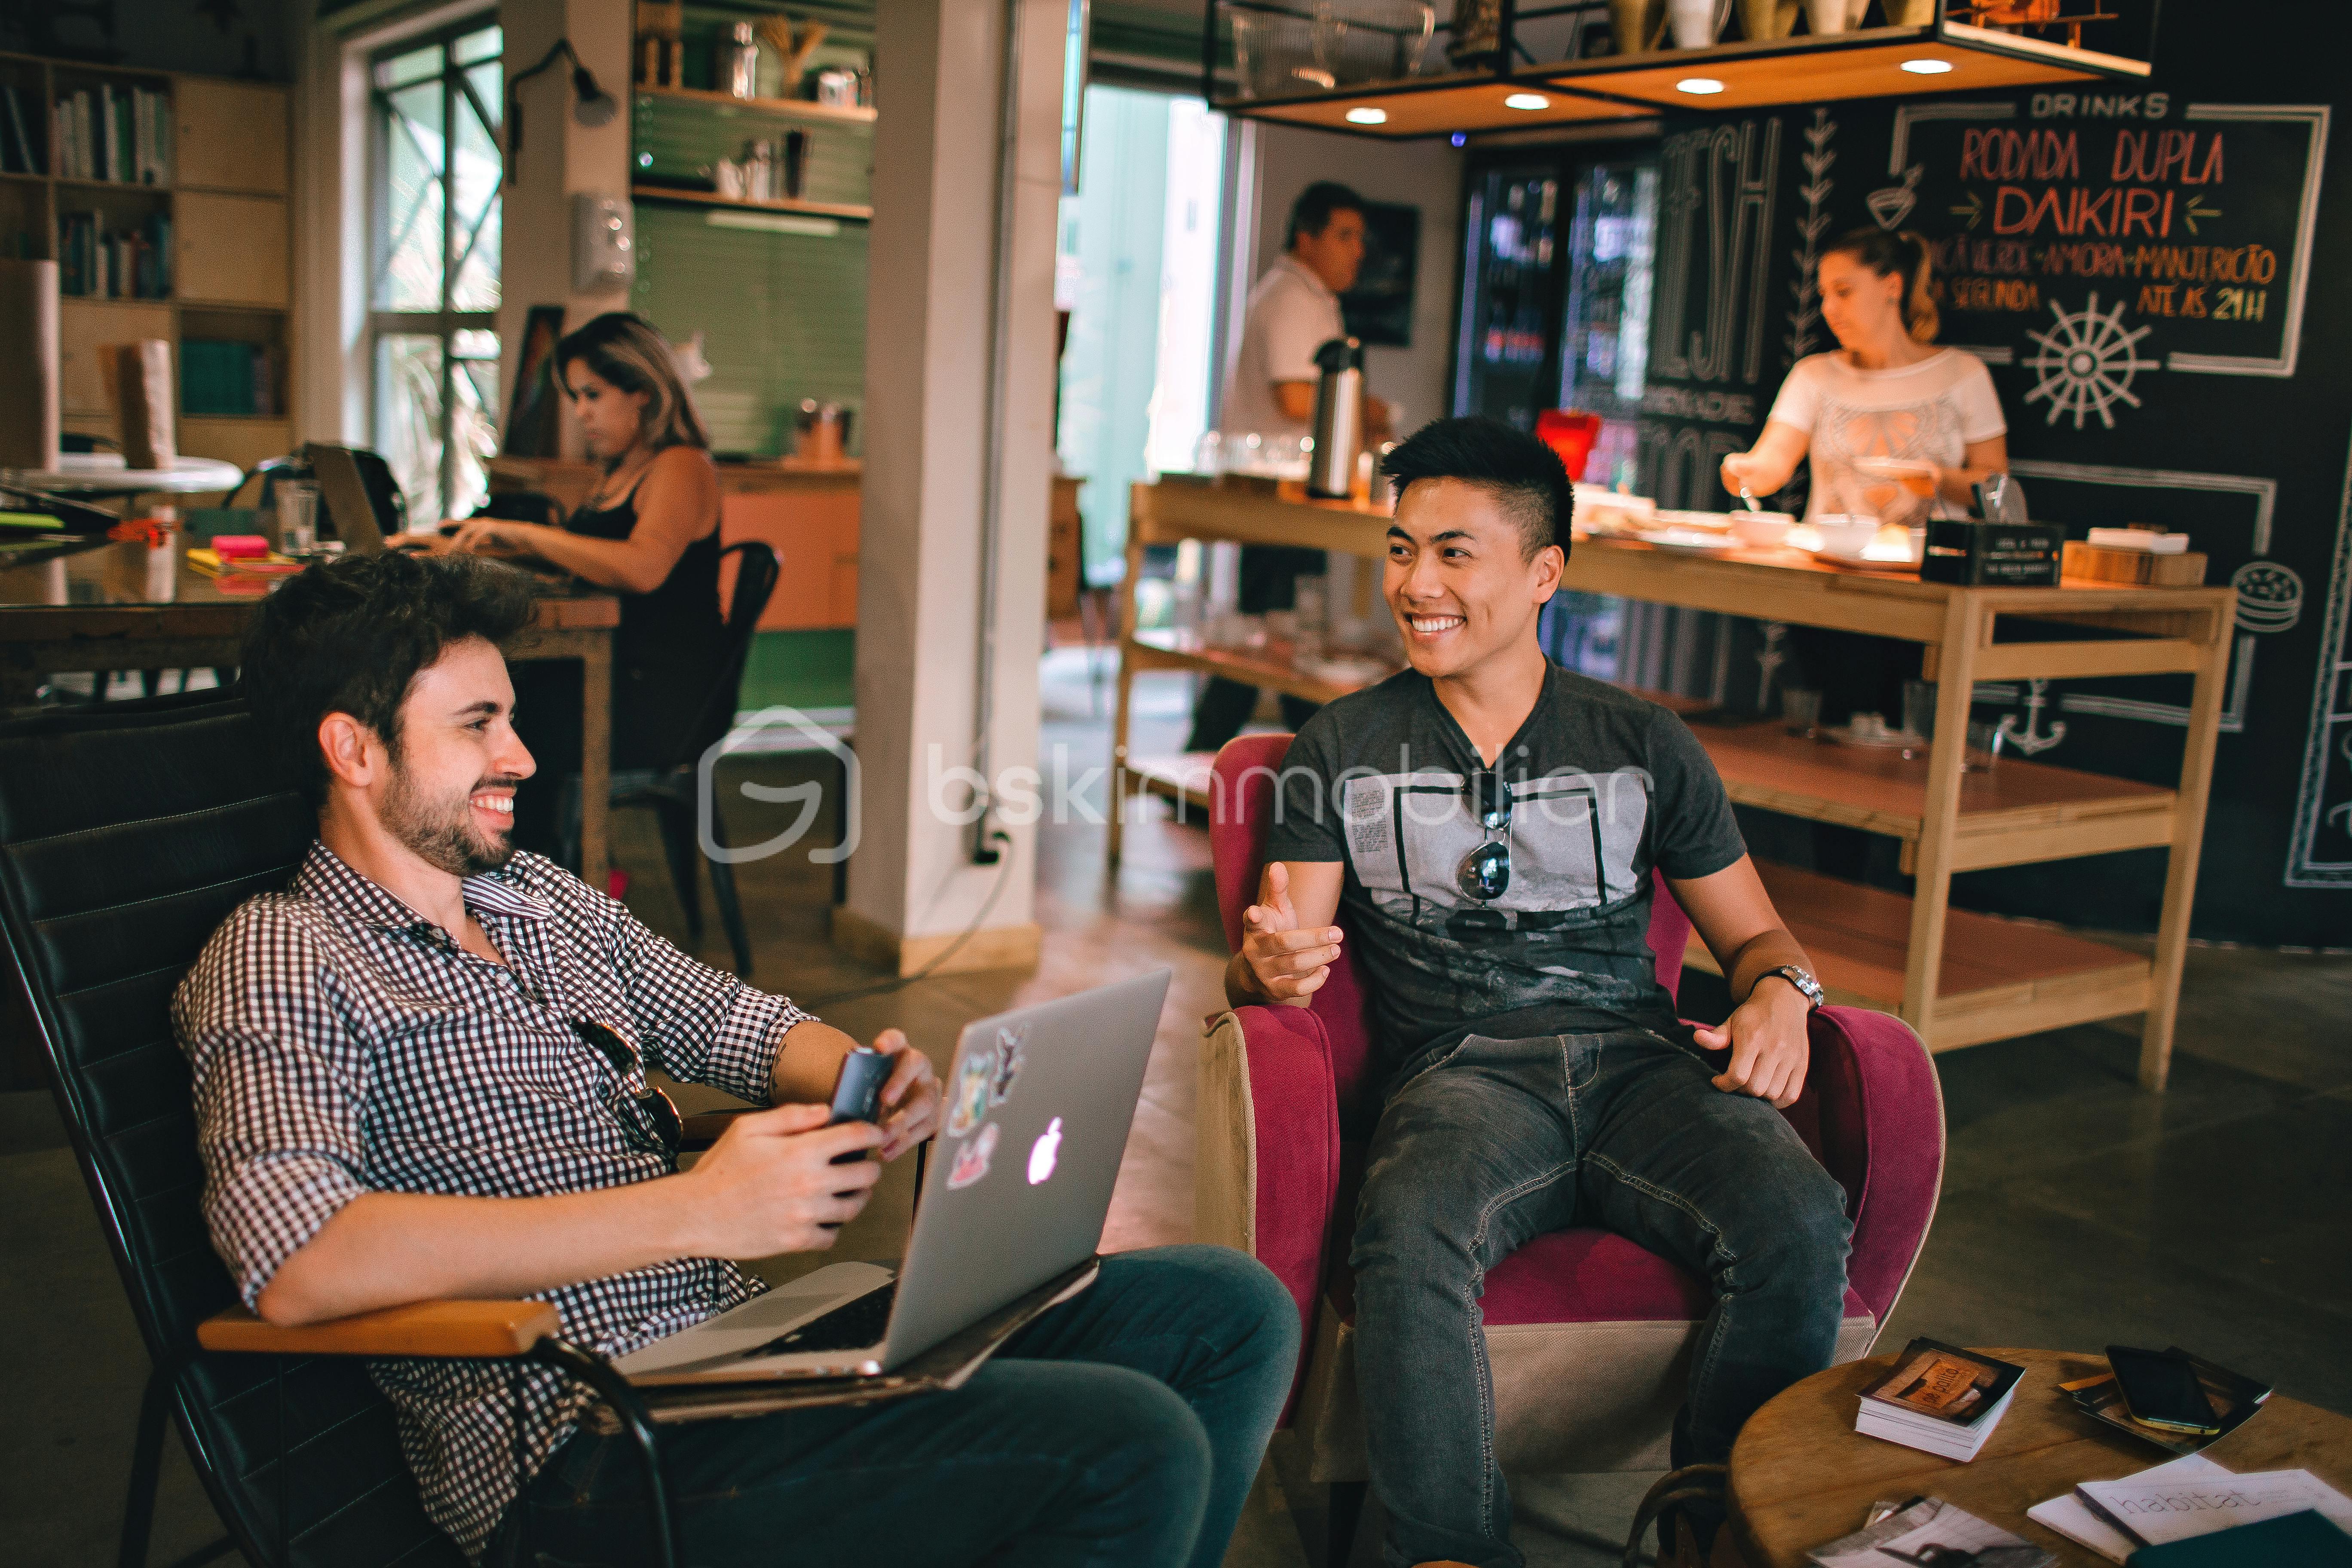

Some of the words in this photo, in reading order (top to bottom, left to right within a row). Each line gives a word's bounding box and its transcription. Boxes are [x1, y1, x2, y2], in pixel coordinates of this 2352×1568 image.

[2030, 92, 2170, 119] DRINKS
[1960, 128, 2079, 181] RODADA
[2111, 129, 2224, 184] DUPLA
[1993, 185, 2175, 238] DAIKIRI
[2109, 1489, 2261, 1514] habitat
